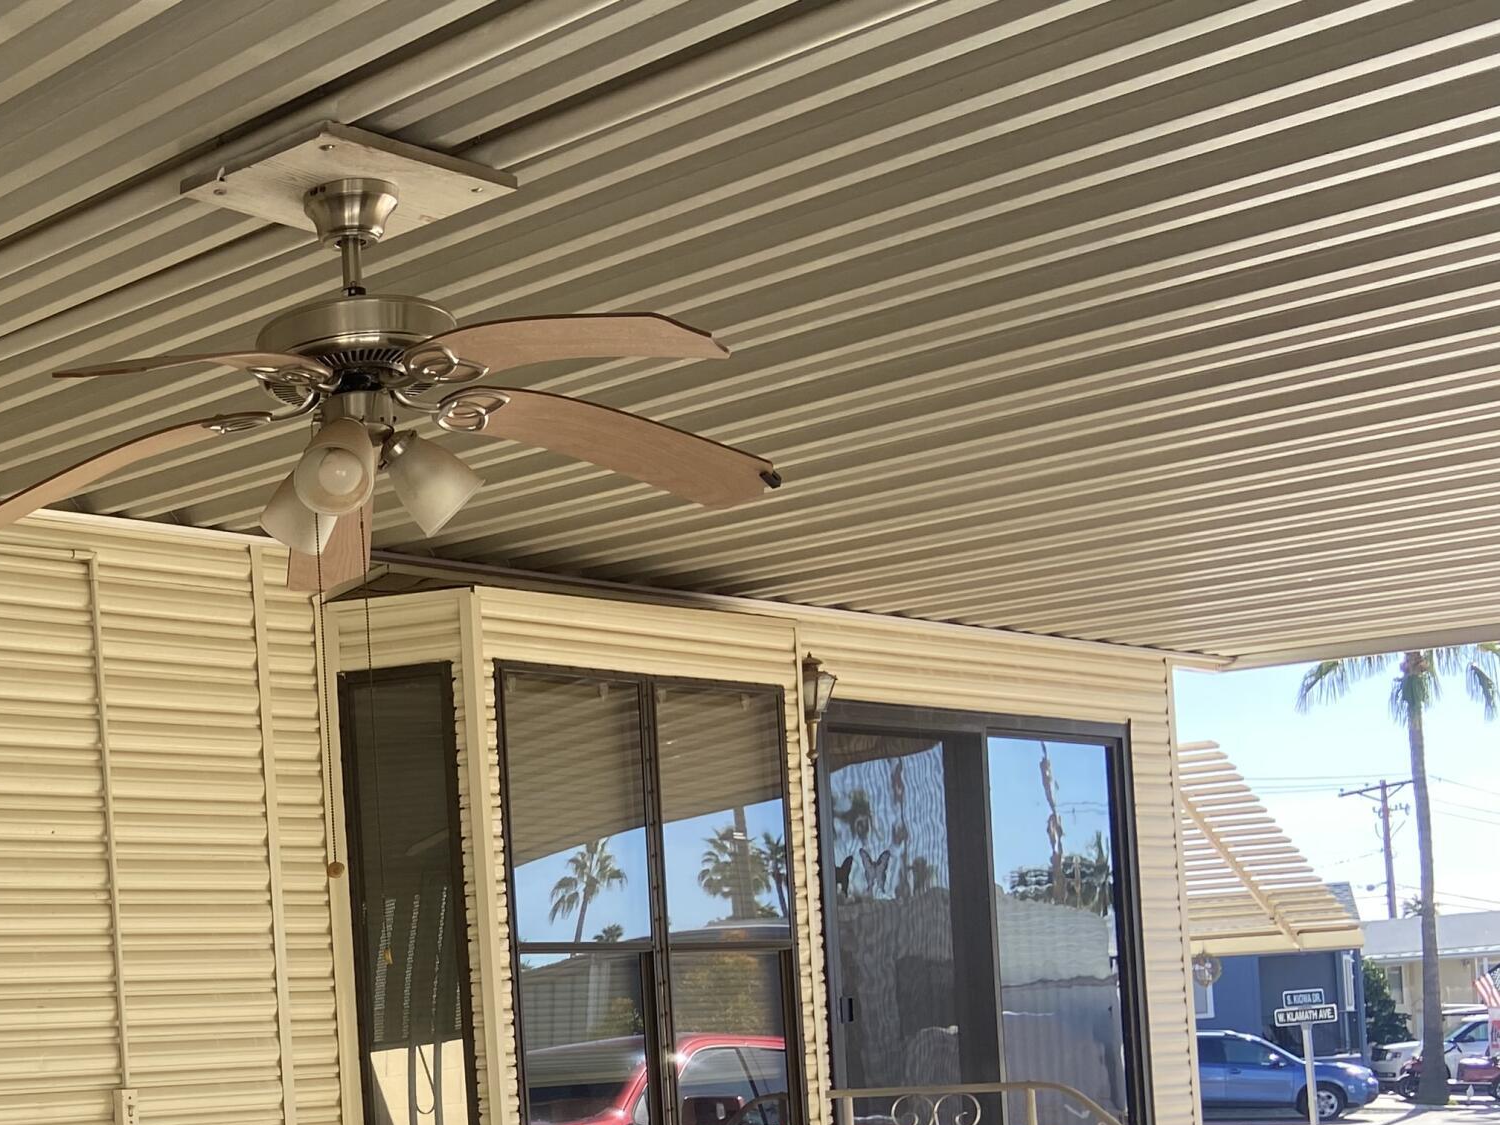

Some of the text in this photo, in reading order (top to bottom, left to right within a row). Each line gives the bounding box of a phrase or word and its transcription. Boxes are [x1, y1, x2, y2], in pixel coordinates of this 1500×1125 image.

[1293, 993, 1312, 1004] KIOWA
[1312, 992, 1322, 1003] DR.
[1277, 1008, 1334, 1023] W. KLAMATH AVE.
